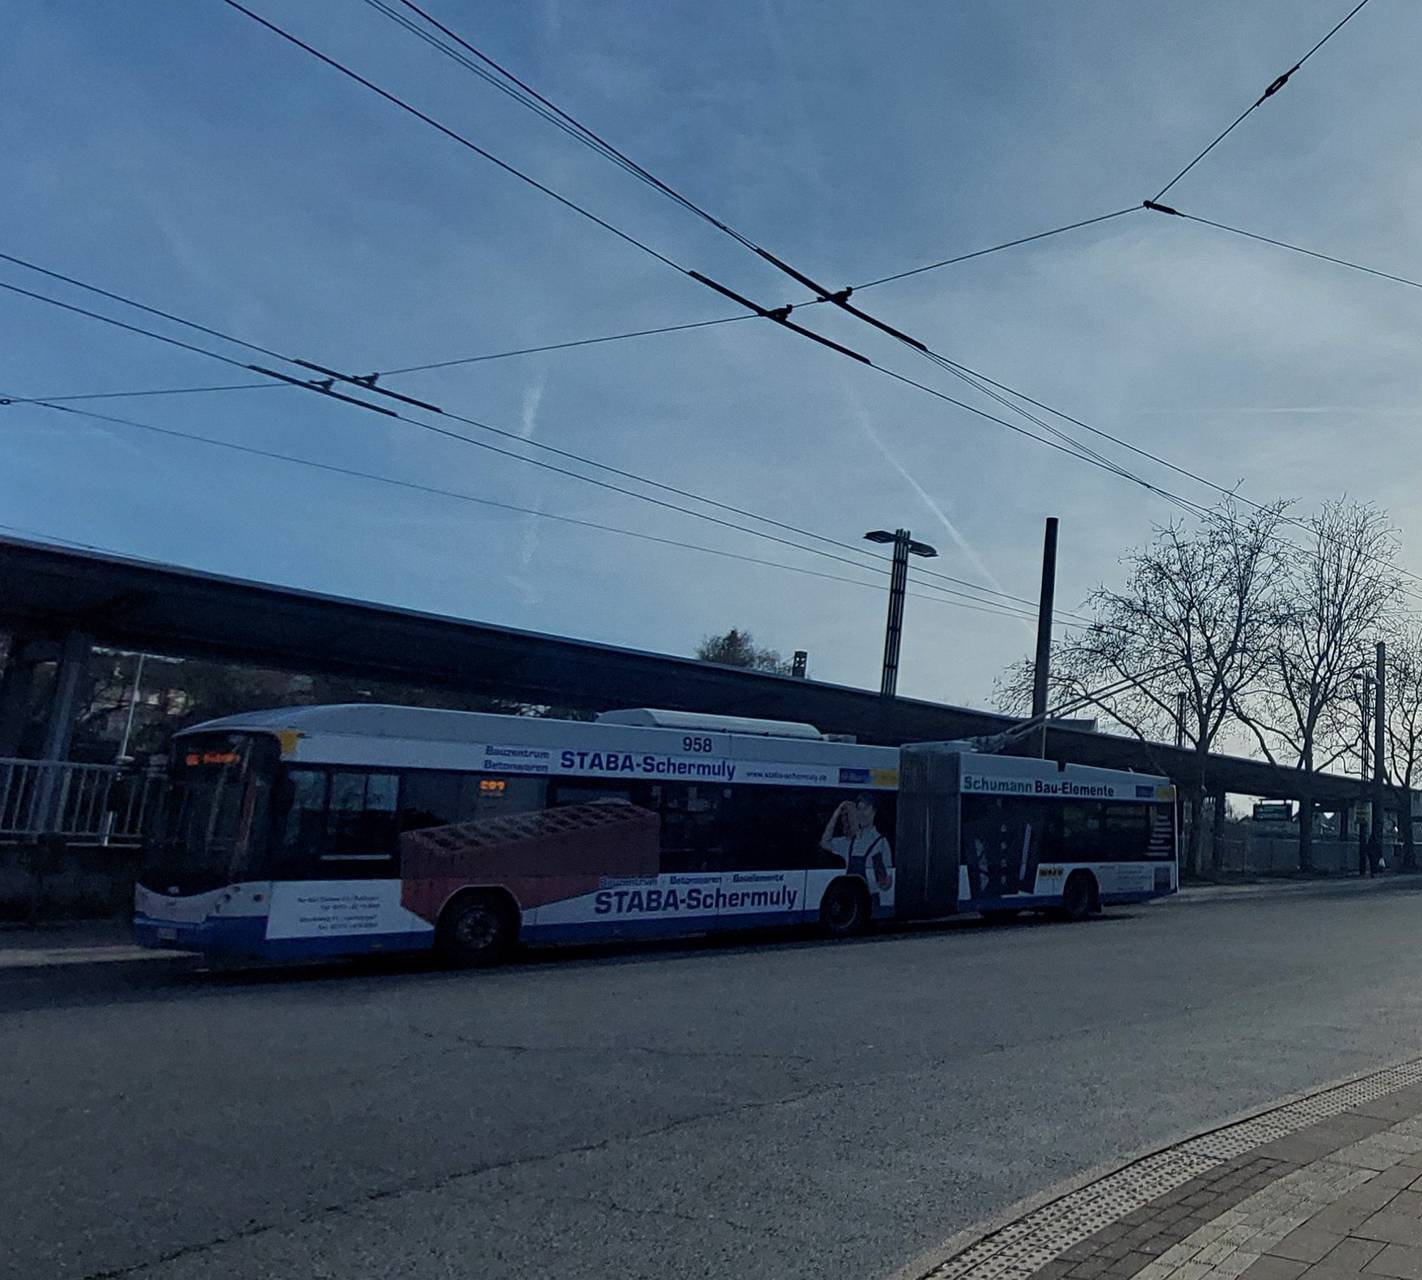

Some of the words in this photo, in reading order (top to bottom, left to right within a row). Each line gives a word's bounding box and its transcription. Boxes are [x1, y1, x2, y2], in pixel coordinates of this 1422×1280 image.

[486, 745, 550, 759] Bauzentrum
[683, 737, 712, 752] 958
[484, 759, 548, 772] Betonwaren
[561, 750, 736, 781] STABA-Schermuly
[964, 776, 1032, 793] Schumann
[1034, 780, 1114, 797] Bau-Elemente
[595, 885, 798, 914] STABA-Schermuly
